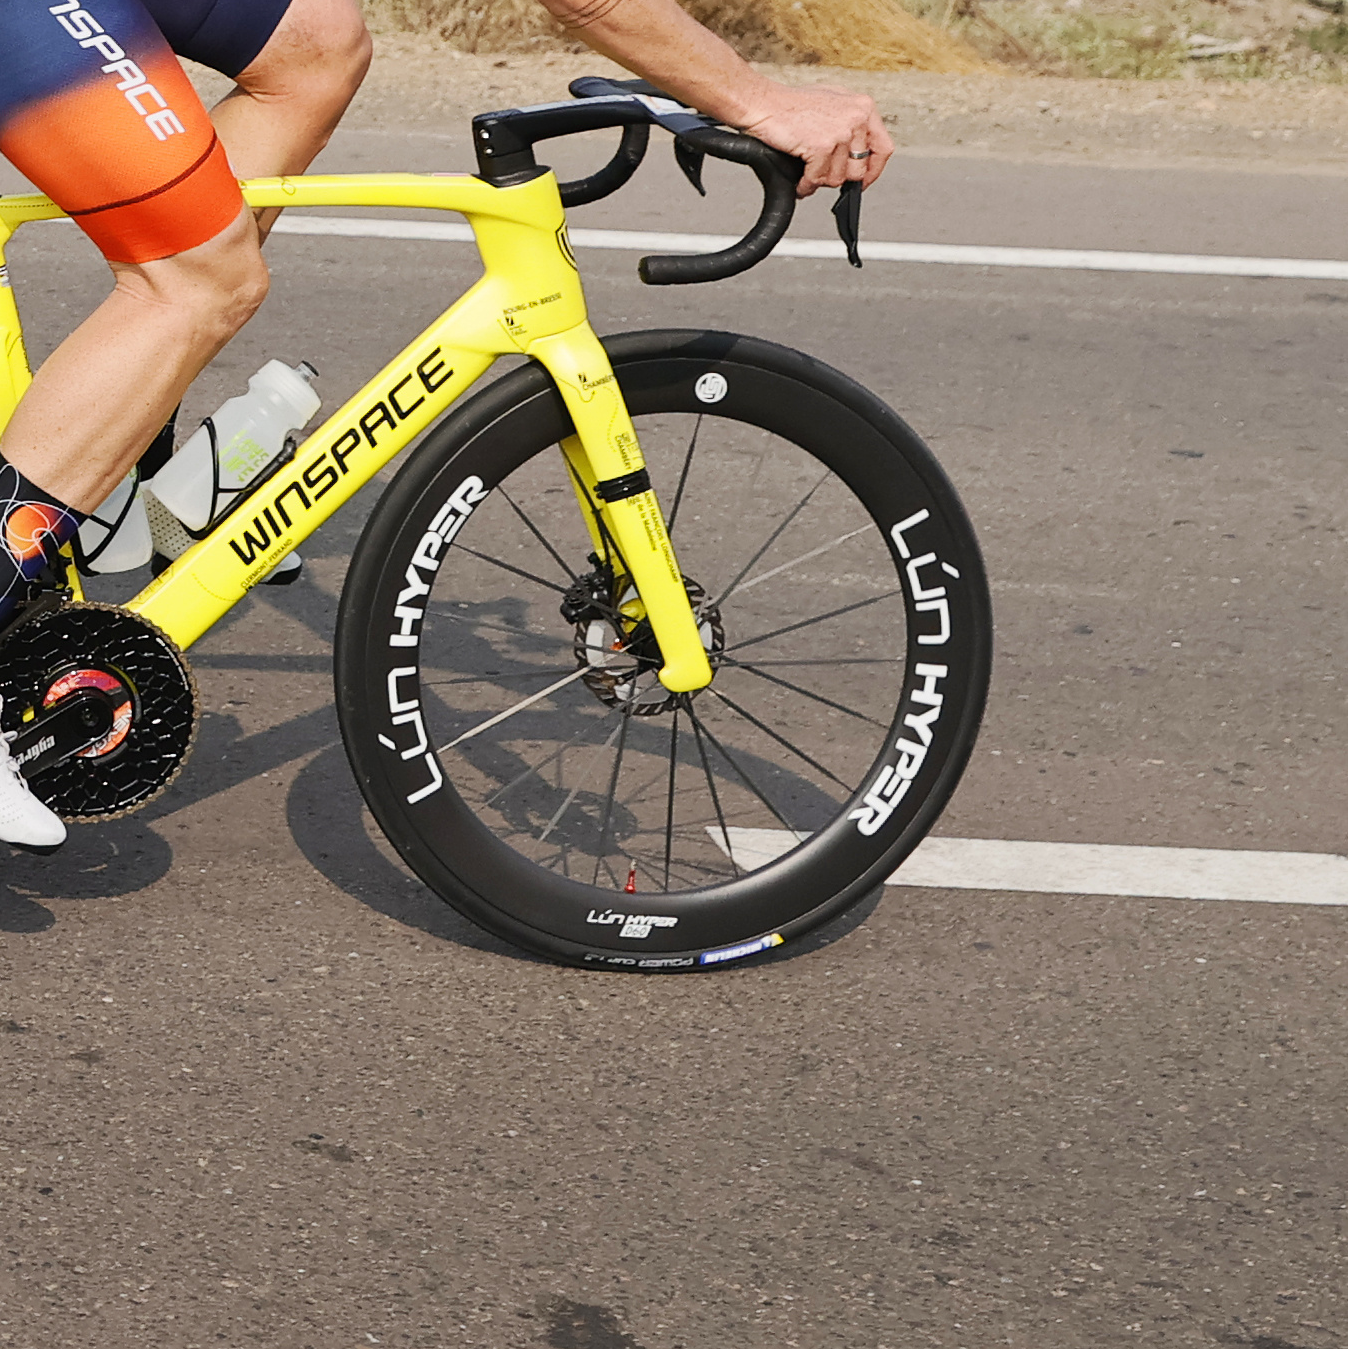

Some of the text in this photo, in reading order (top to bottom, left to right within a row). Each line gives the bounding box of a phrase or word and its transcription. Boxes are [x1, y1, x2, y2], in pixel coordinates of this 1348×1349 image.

[228, 346, 454, 566] WINSPACE
[389, 475, 488, 647] HYPER
[848, 664, 948, 837] HYPER
[625, 914, 678, 927] HYPER
[638, 956, 694, 968] POWER
[705, 943, 762, 964] MICHELIN
